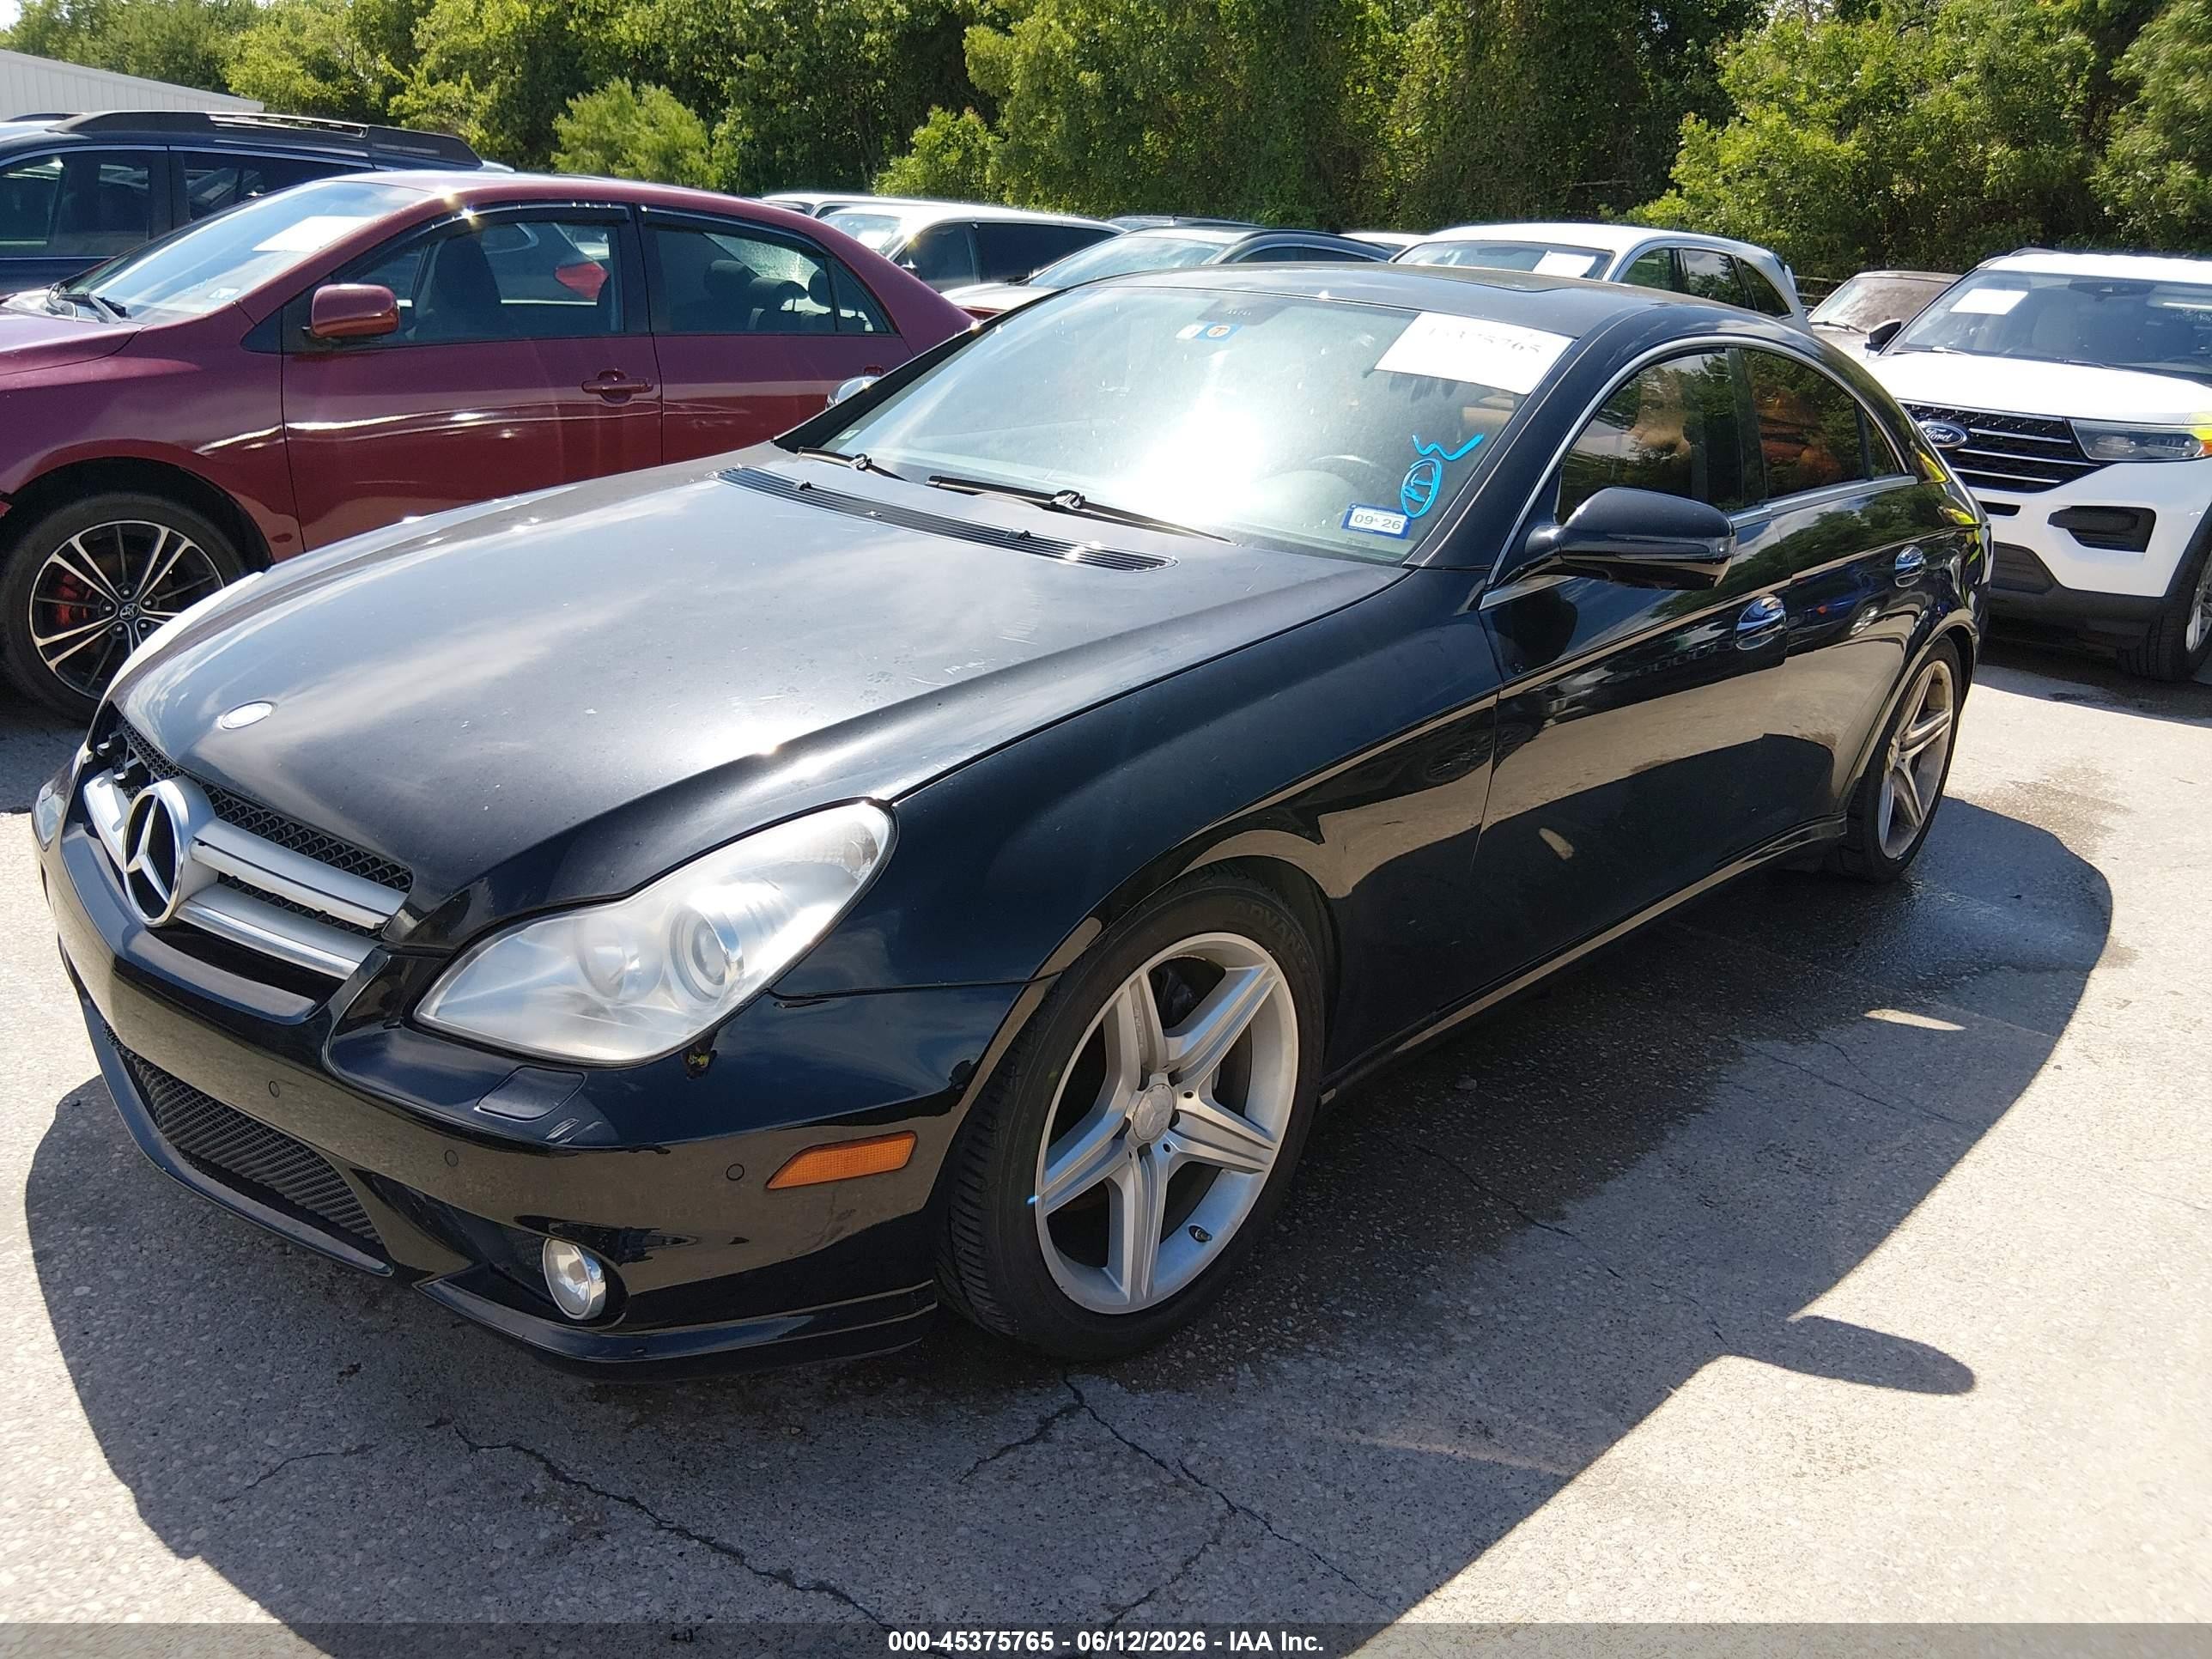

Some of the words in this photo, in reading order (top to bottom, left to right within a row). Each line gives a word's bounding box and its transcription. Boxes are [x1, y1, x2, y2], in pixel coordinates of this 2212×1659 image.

[1926, 427, 1954, 442] Ford
[1353, 514, 1374, 526] 09
[1381, 519, 1402, 530] 26
